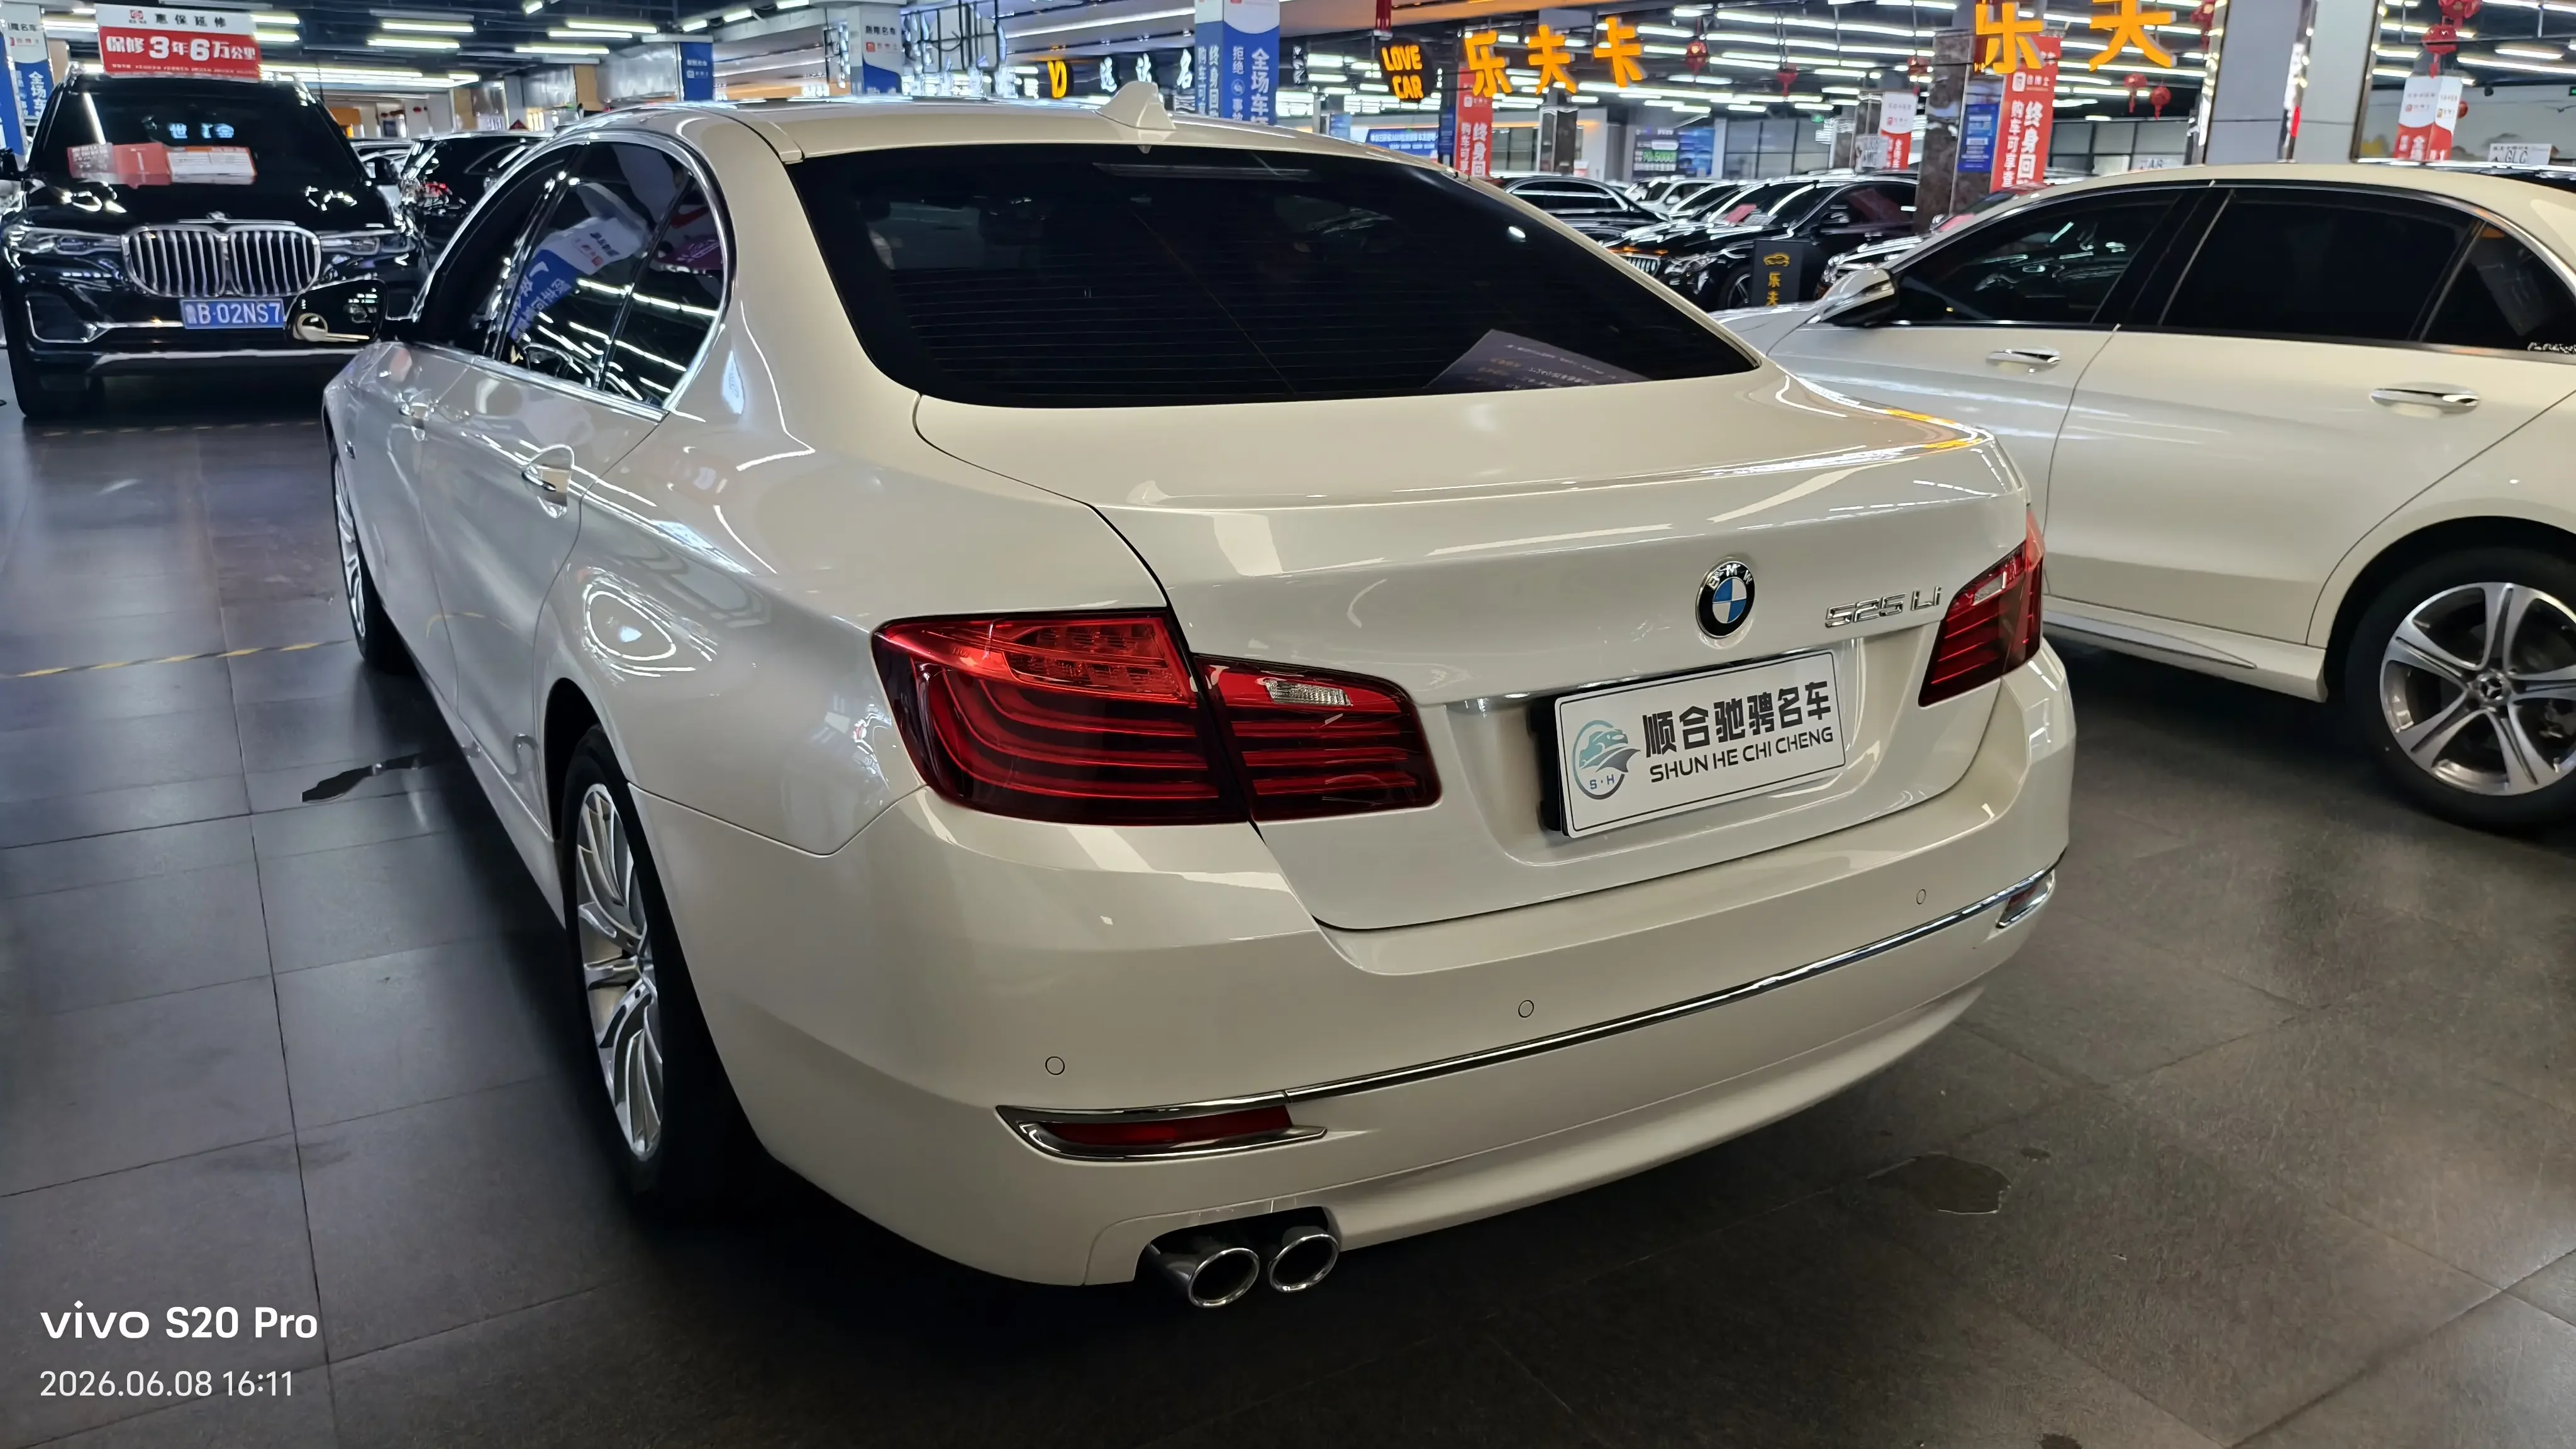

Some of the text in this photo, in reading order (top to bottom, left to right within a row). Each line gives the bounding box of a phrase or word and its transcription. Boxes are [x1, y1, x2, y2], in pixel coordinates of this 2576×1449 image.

[106, 36, 255, 61] 保修3年6万公里
[1233, 45, 1244, 74] 拒绝
[1381, 45, 1423, 70] LOVE
[1465, 17, 1643, 97] 乐夫卡
[1392, 75, 1424, 99] CAR
[1766, 272, 1781, 307] 乐夫
[1707, 564, 1753, 590] BMW
[1642, 680, 1831, 758] 顺合驰骋名车
[1650, 726, 1833, 783] SHUN HE CHI CHENG
